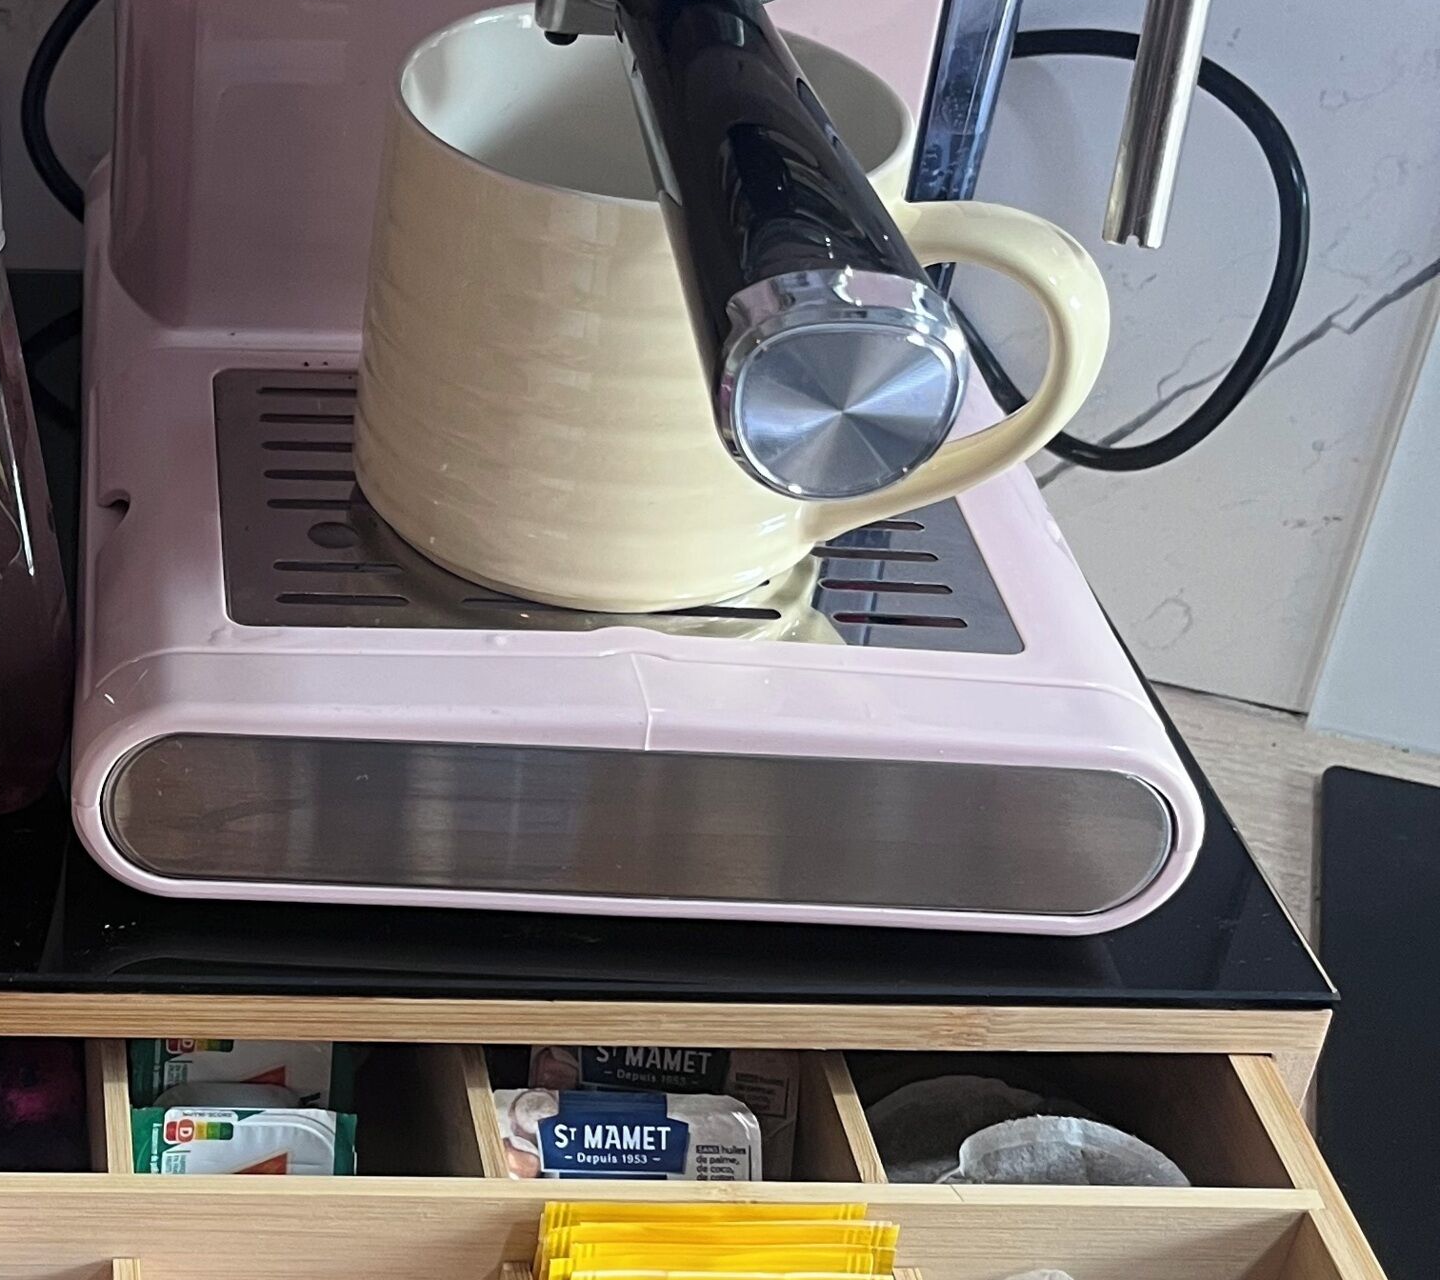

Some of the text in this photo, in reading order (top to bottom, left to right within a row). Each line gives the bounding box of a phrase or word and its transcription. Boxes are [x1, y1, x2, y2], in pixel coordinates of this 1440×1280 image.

[625, 1047, 713, 1075] MAMET
[616, 1068, 657, 1084] Depuis
[180, 1126, 193, 1138] D
[584, 1124, 672, 1151] MAMET
[576, 1152, 648, 1166] Depuis 1953
[696, 1156, 708, 1164] de
[696, 1165, 708, 1173] de
